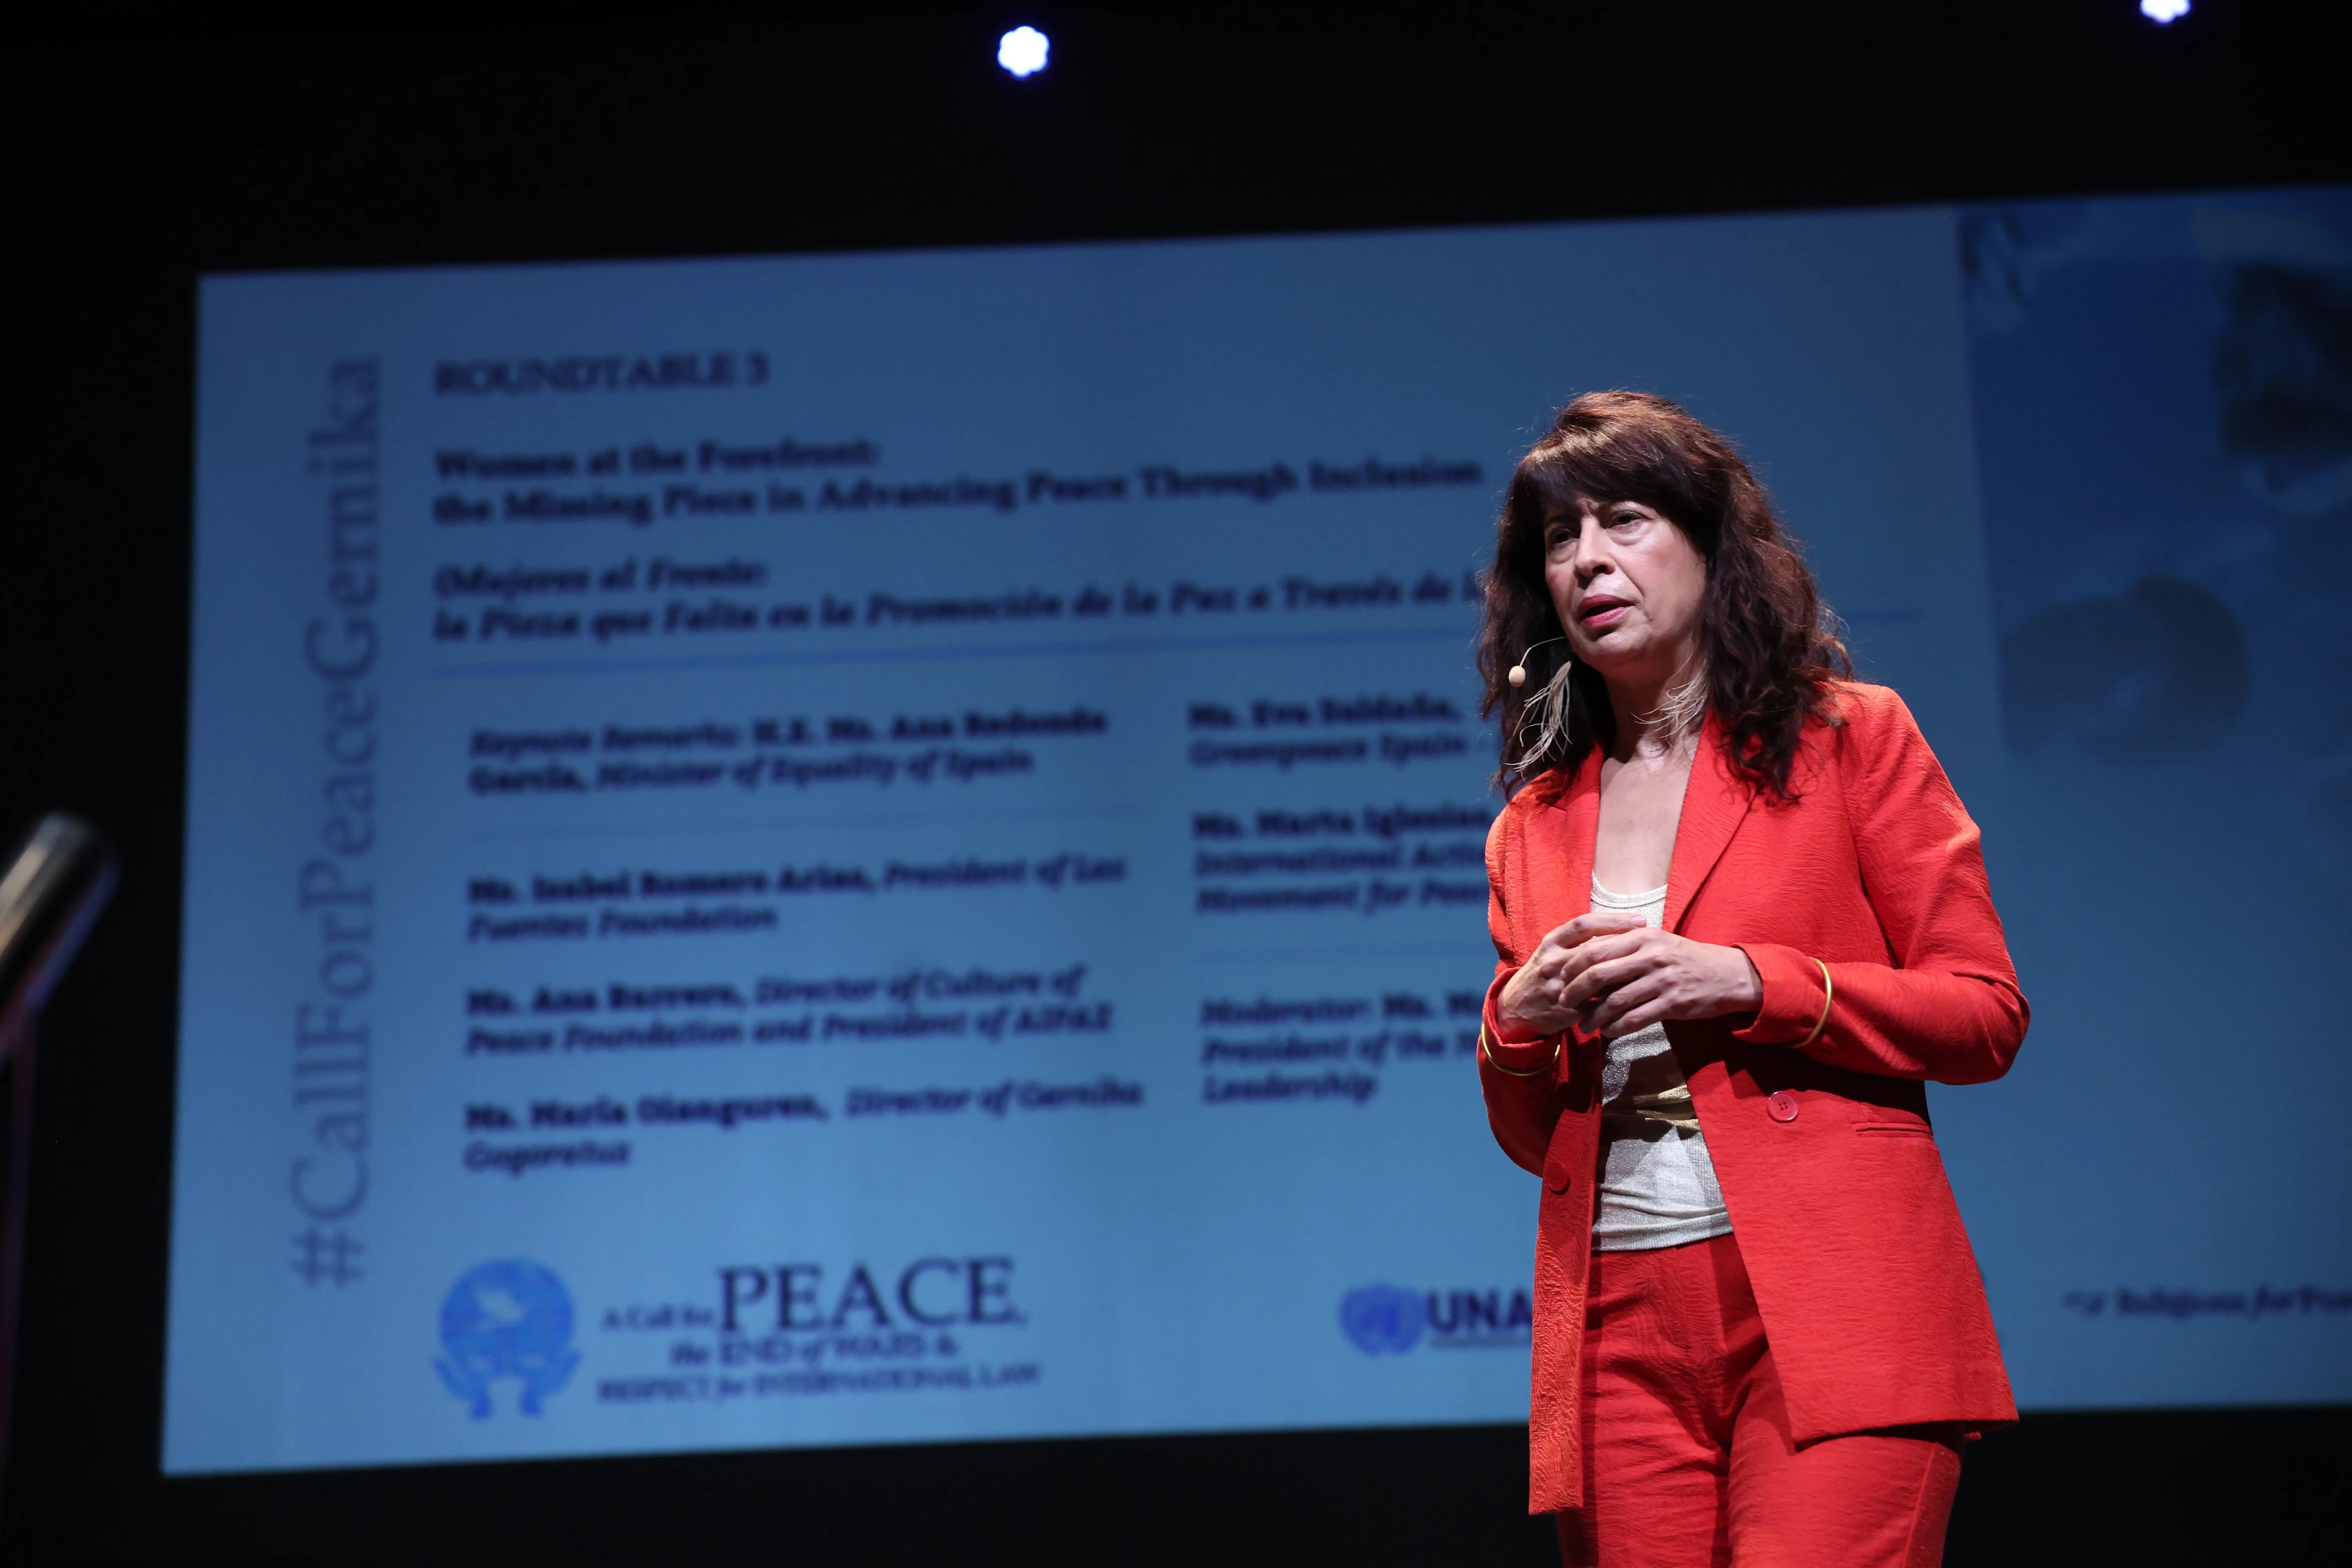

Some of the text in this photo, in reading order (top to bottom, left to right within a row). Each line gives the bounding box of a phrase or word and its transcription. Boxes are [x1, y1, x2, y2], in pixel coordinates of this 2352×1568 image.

[749, 352, 769, 384] 3
[290, 356, 381, 1287] #CallForPeaceGernika
[1426, 1289, 1532, 1334] UNA
